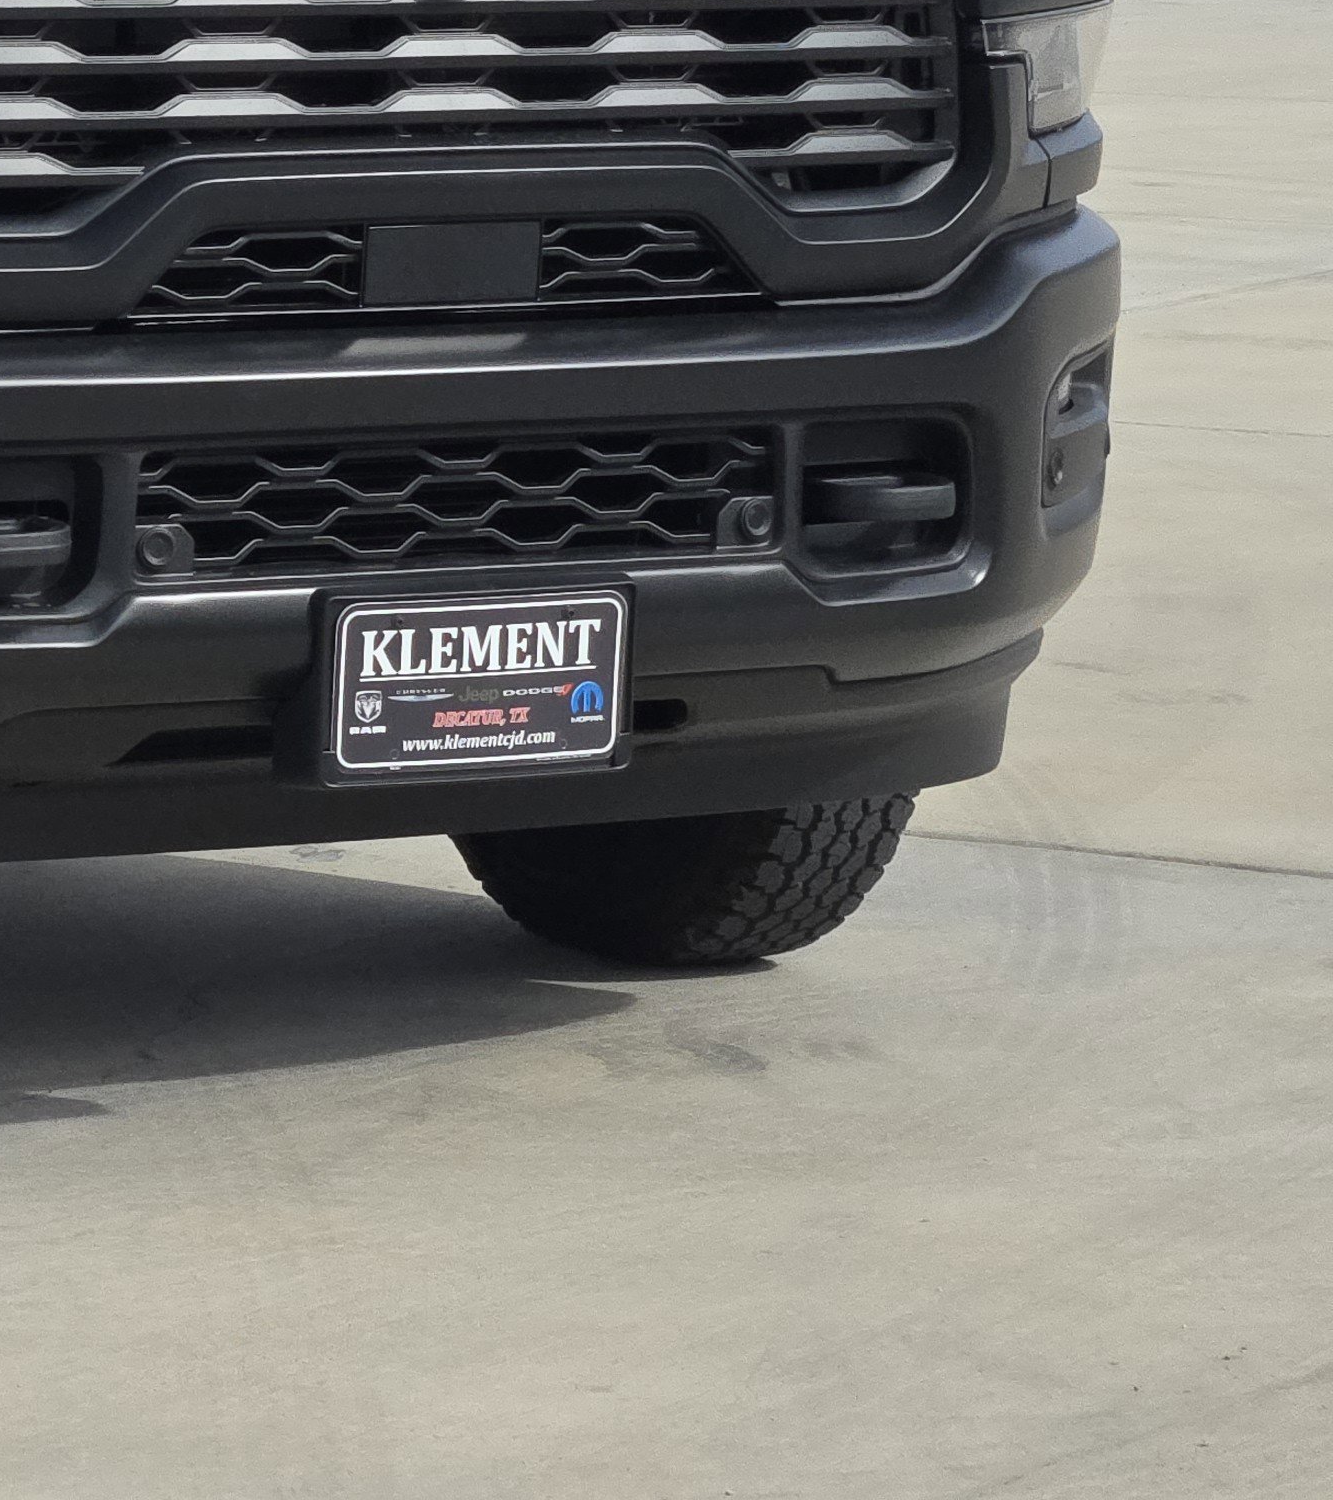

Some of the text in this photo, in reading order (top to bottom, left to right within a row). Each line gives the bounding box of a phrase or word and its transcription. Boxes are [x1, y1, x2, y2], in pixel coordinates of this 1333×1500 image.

[359, 618, 602, 678] KLEMENT
[458, 685, 500, 704] Jeep
[502, 685, 565, 697] DODGE
[432, 706, 531, 728] DECATUR, TX
[402, 729, 556, 753] www.klementcjd.com
